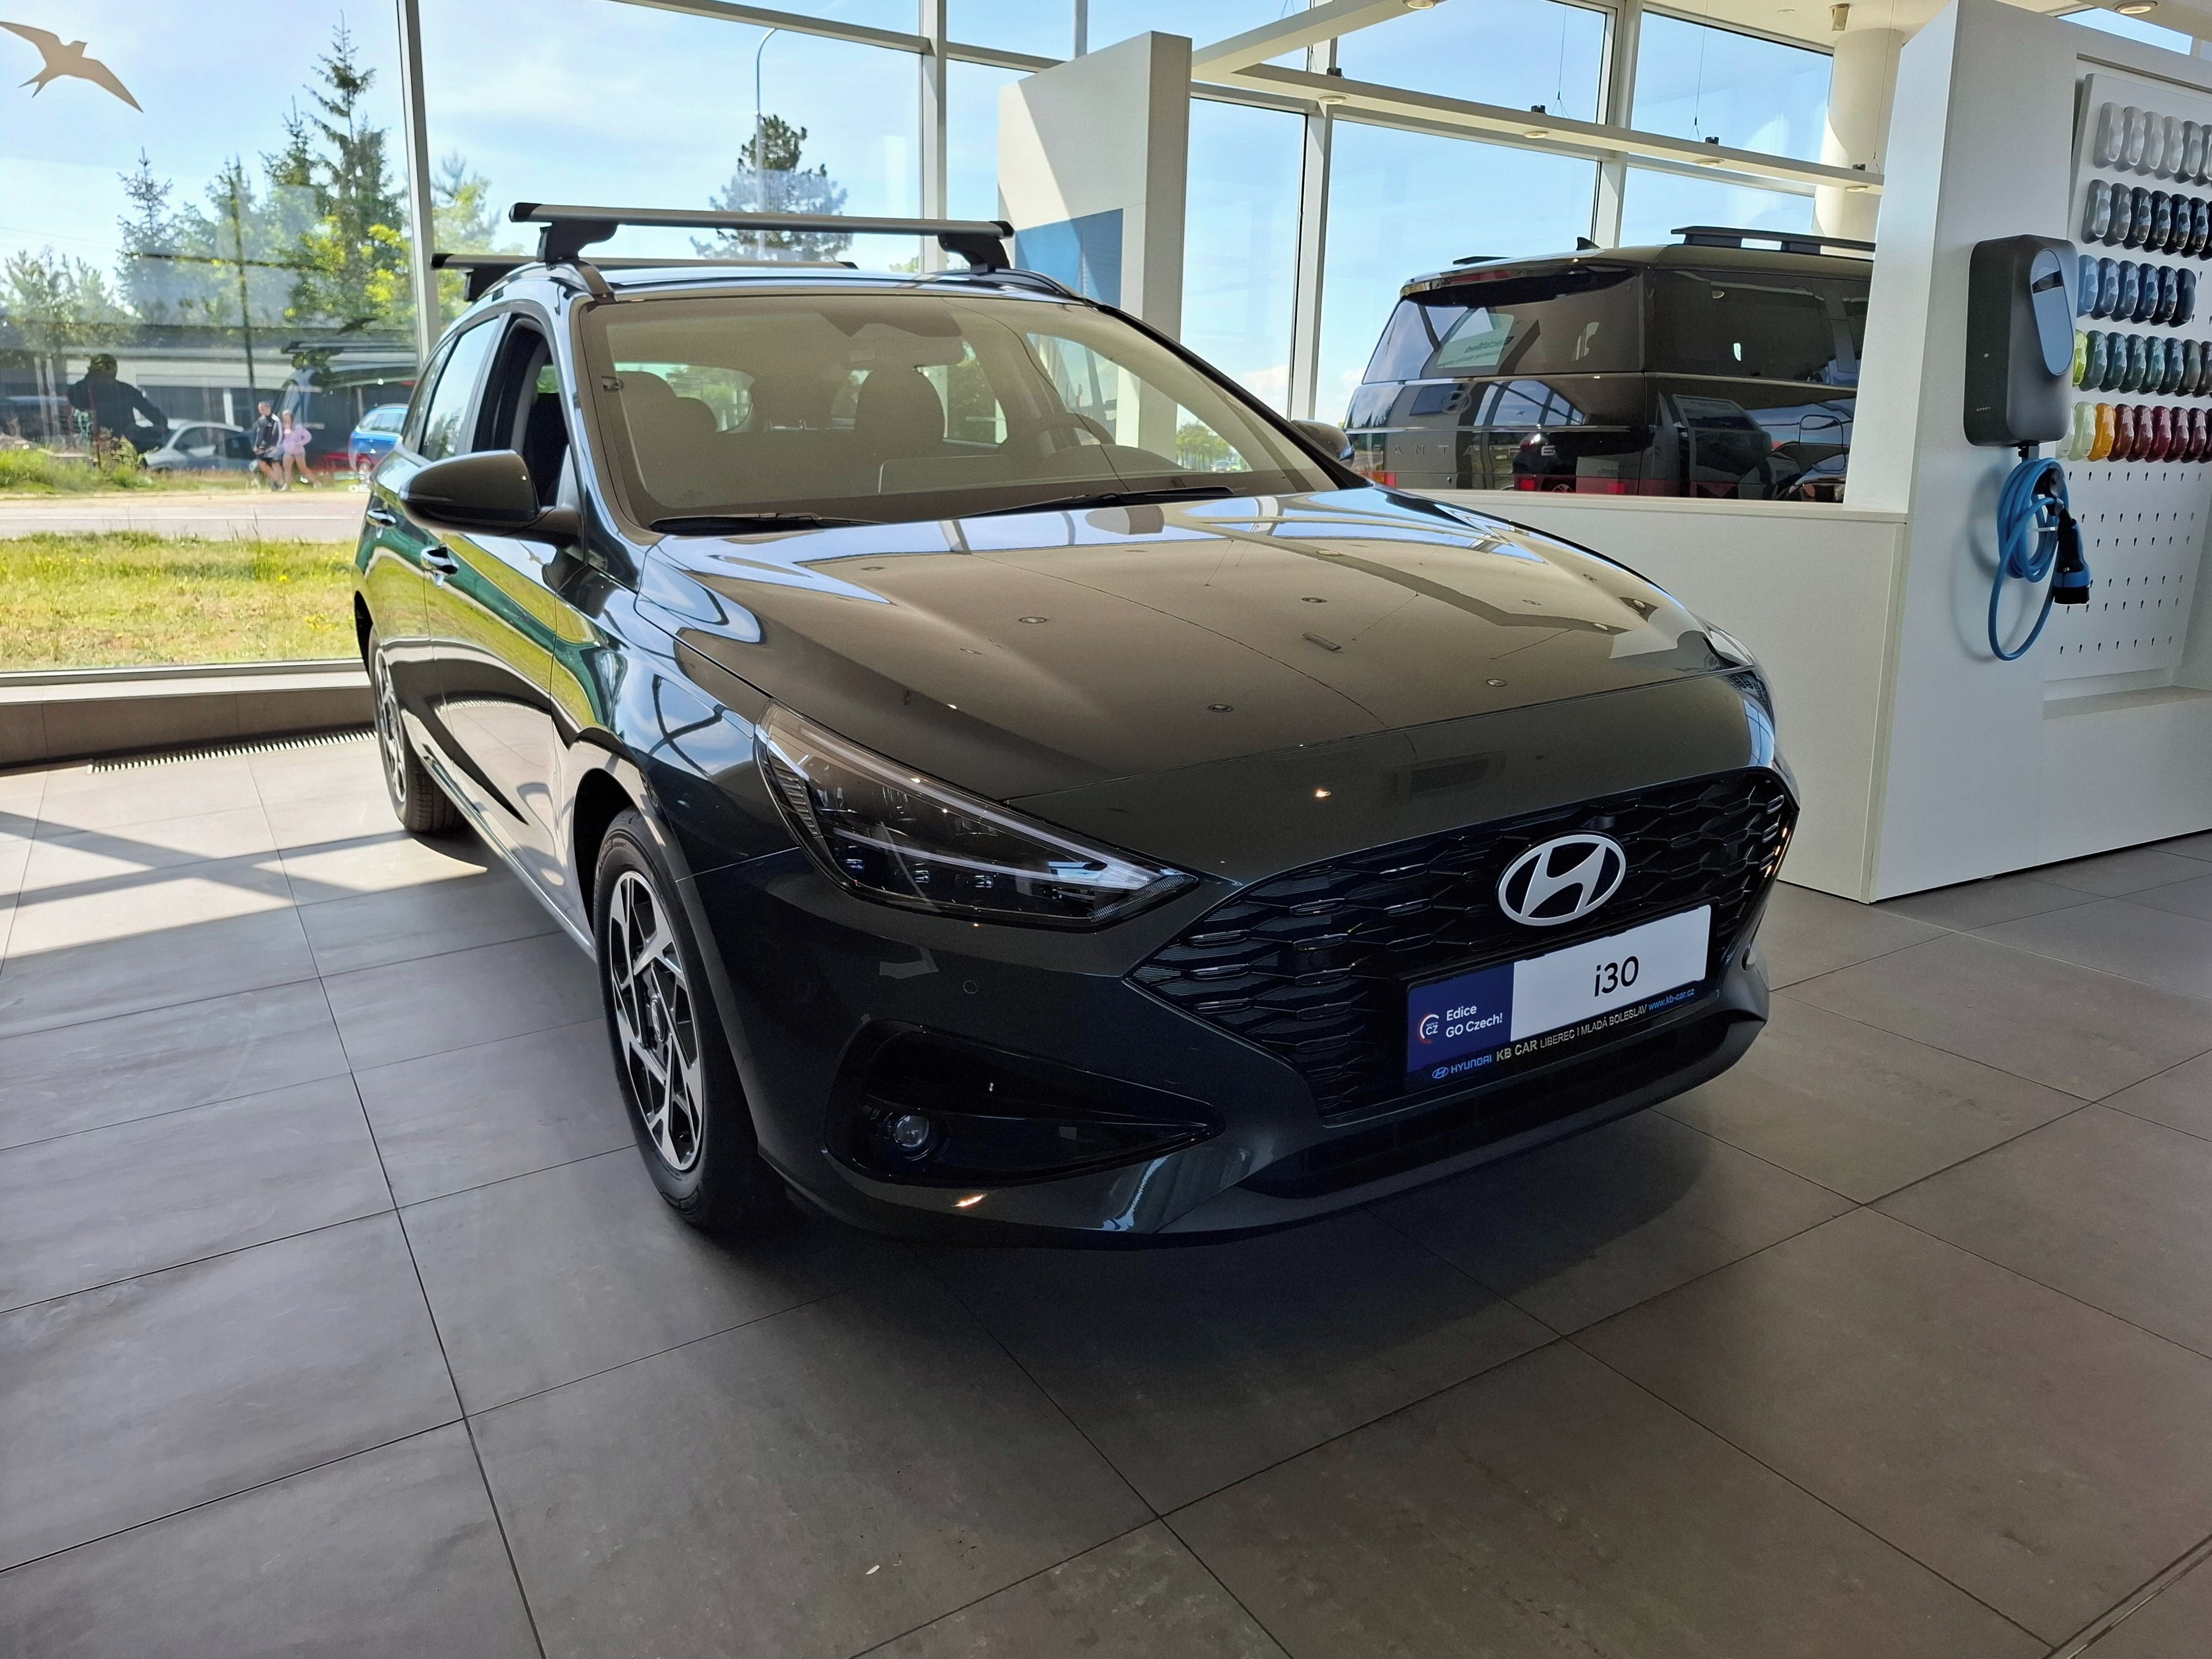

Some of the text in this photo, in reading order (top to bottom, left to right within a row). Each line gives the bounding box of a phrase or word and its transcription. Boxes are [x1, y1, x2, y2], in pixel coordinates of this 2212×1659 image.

[1372, 445, 1556, 456] SANTA FE
[1594, 955, 1639, 998] i30
[1446, 1005, 1477, 1021] Edice
[1426, 1024, 1438, 1036] CZ
[1445, 1012, 1503, 1038] GO Czech!
[1451, 1054, 1492, 1074] HYUNDAI
[1495, 1047, 1512, 1062] KB
[1514, 1039, 1539, 1056] CAR
[1539, 1028, 1576, 1049] LIBEREC
[1580, 1015, 1608, 1036] MLADÁ
[1609, 1003, 1648, 1026] BOLESLAV
[1648, 987, 1695, 1011] www.kb-car.cz
